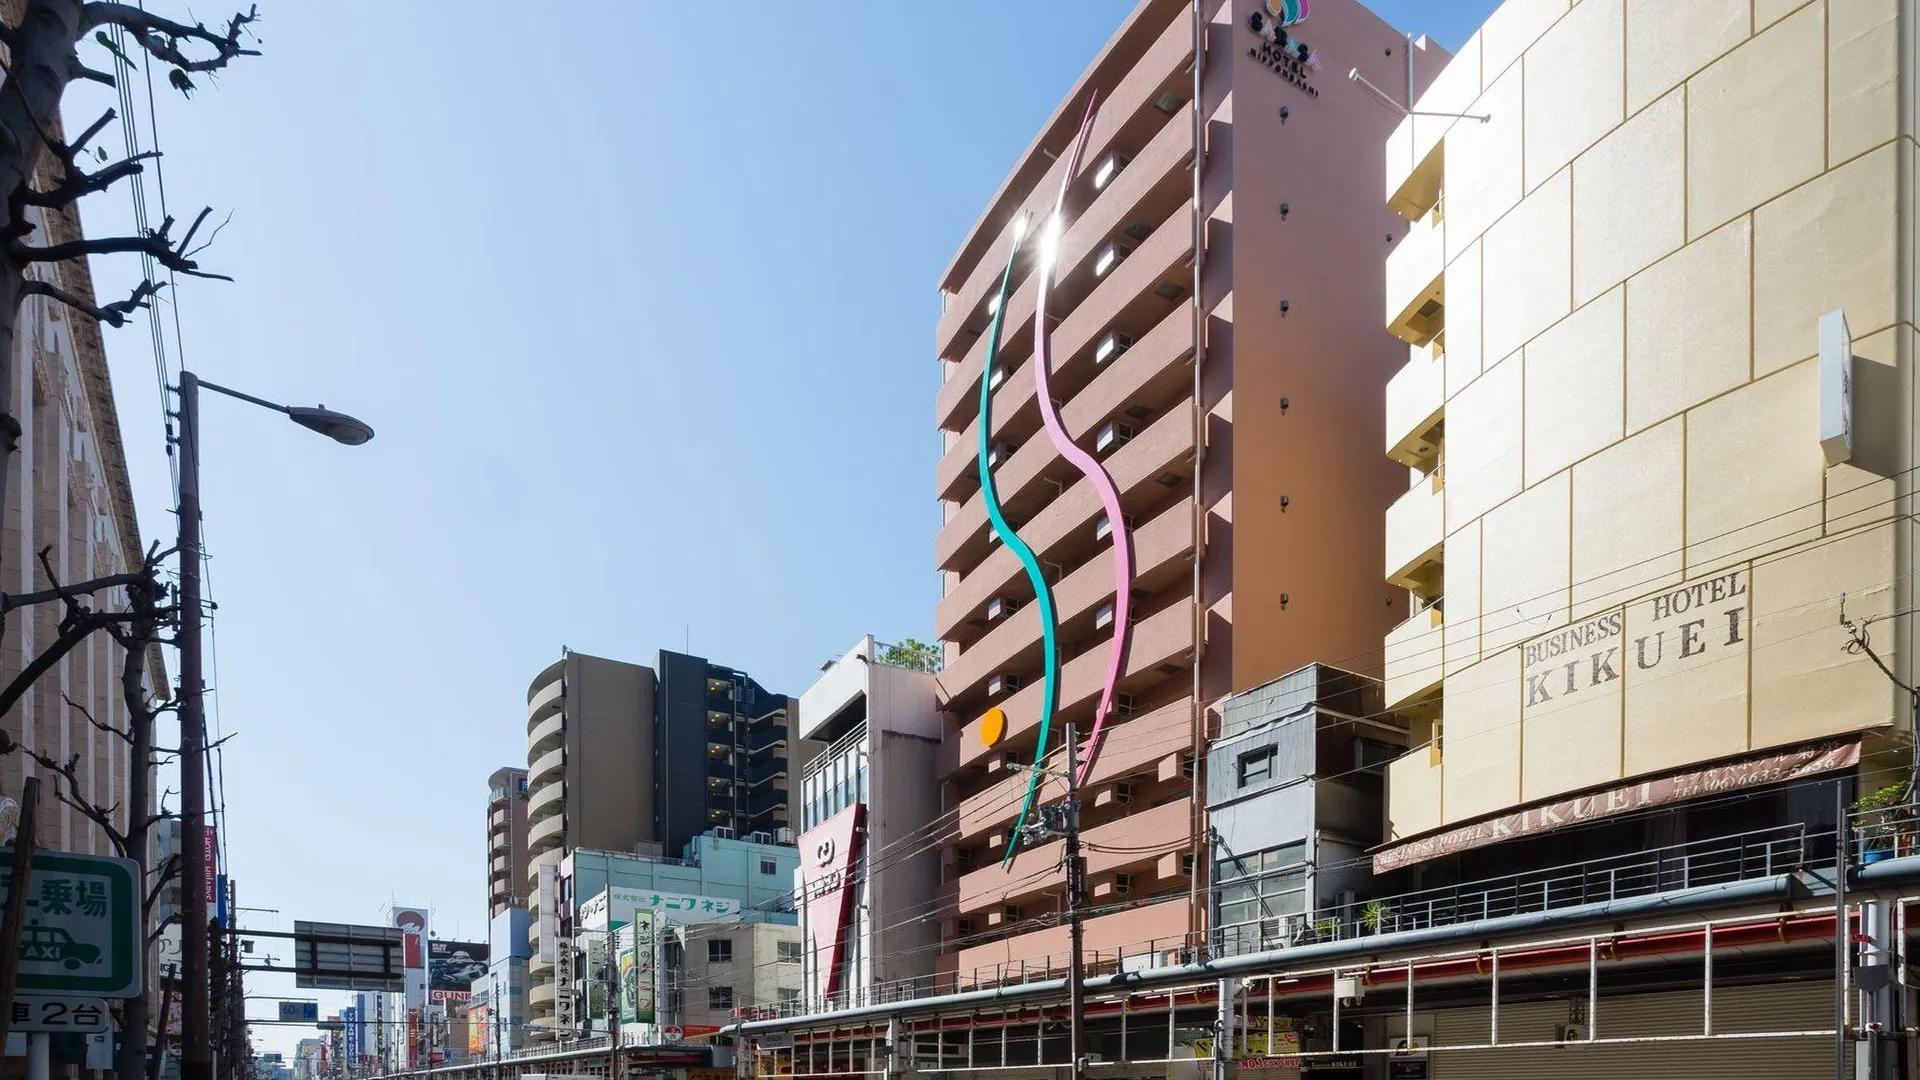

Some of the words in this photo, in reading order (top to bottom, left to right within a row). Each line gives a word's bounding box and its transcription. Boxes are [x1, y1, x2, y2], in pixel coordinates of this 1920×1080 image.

[1263, 42, 1306, 78] HOTEL
[1525, 611, 1622, 668] BUSINESS
[1652, 572, 1746, 621] HOTEL
[1526, 607, 1744, 708] KIKUEI
[1491, 782, 1651, 840] KIKUEI
[649, 894, 730, 913] ナニワネジ
